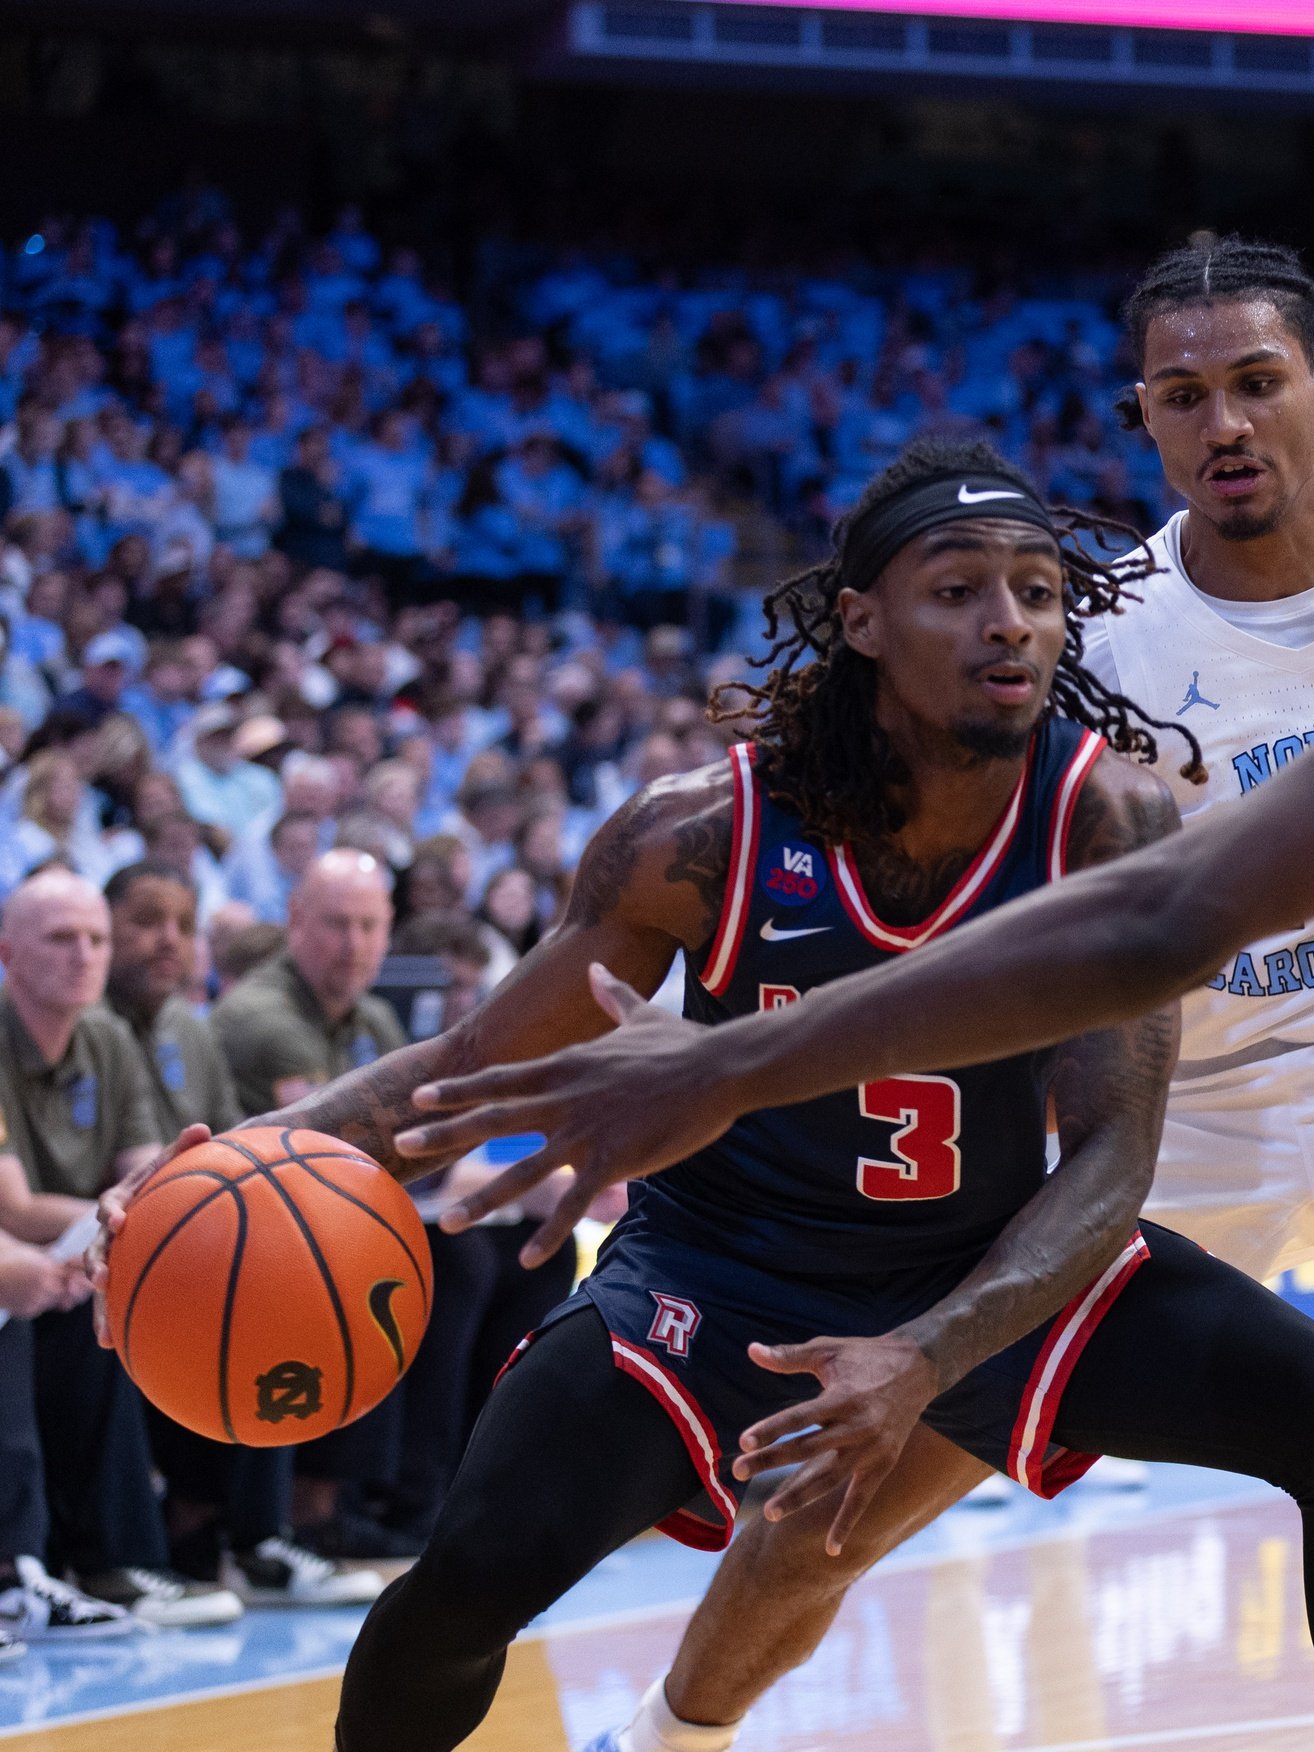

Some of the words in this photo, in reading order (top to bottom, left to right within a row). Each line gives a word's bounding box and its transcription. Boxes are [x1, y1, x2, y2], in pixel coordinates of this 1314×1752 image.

[766, 867, 819, 899] 250
[783, 846, 814, 878] VA
[856, 1073, 961, 1201] 3
[647, 1290, 703, 1358] R
